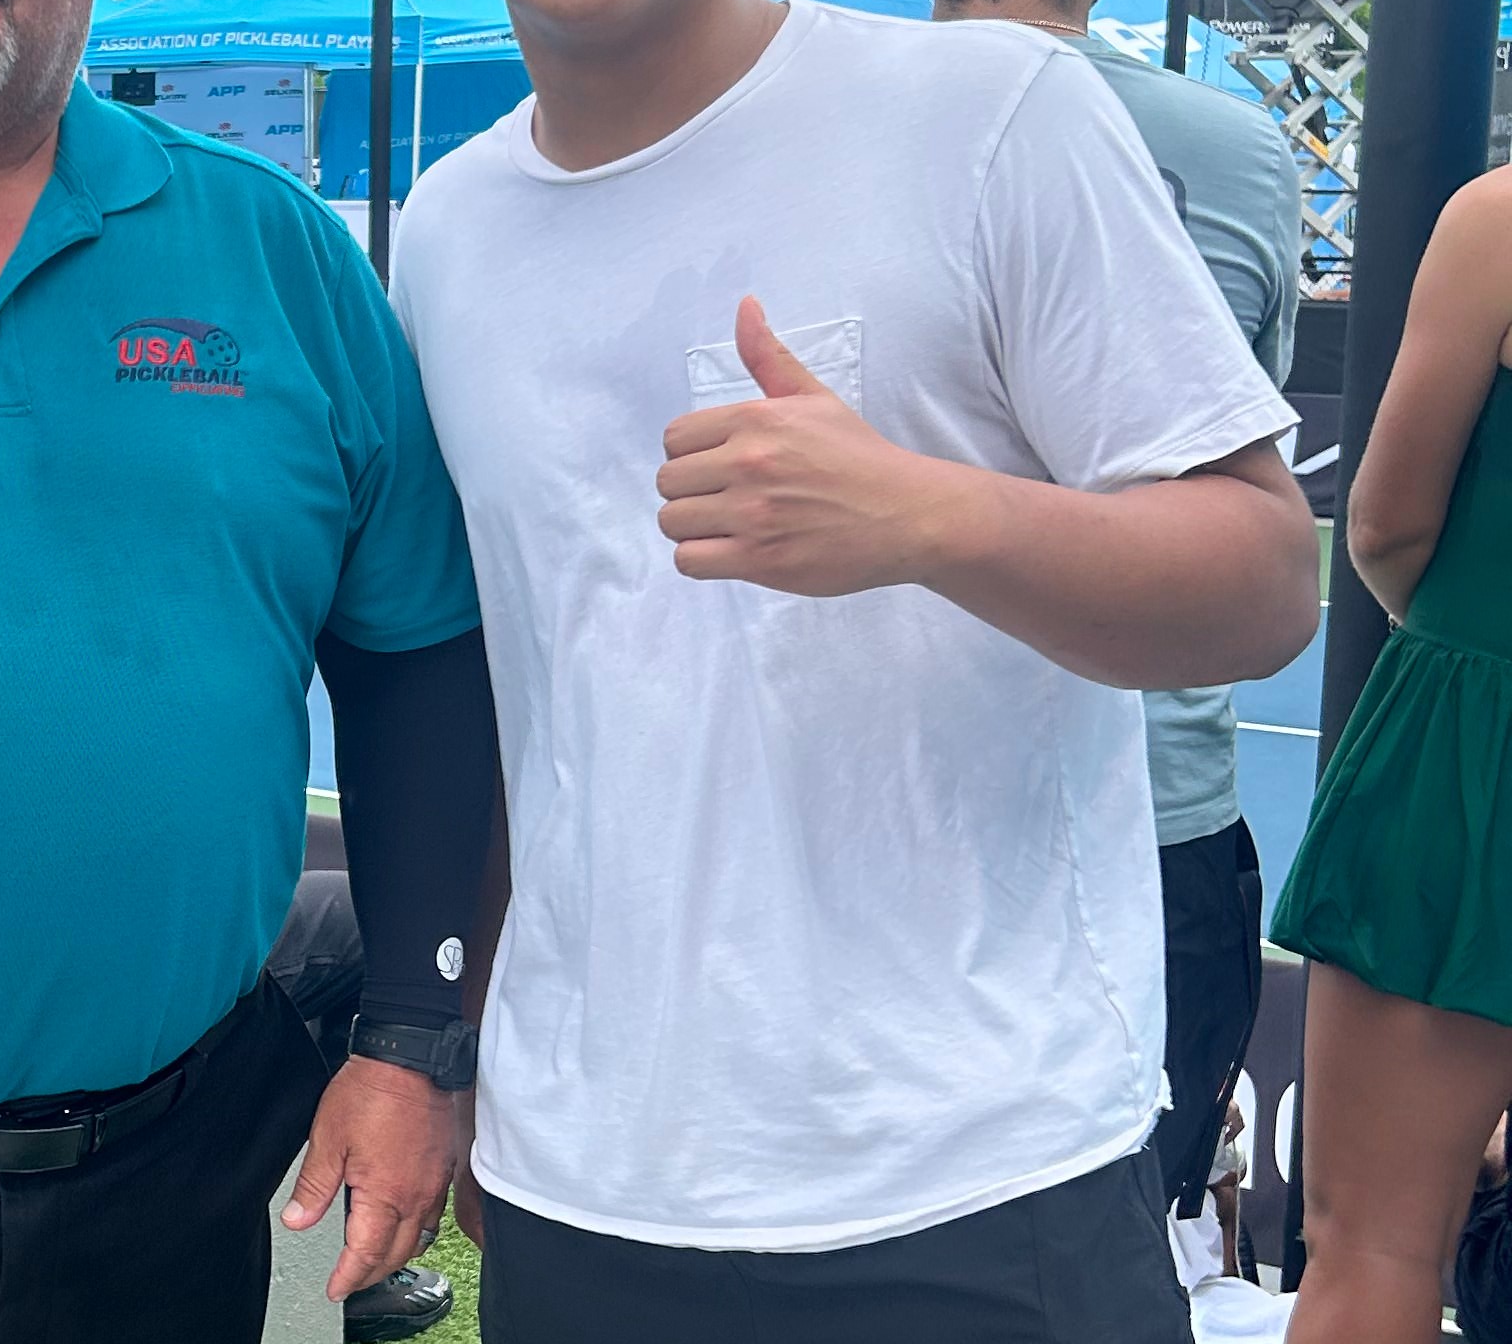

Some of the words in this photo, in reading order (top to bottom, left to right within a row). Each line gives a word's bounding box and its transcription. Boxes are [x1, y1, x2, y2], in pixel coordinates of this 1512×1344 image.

[97, 34, 197, 52] ASSOCIATION
[201, 32, 221, 47] OF
[225, 31, 322, 49] PICKLEBALL
[326, 34, 401, 50] PLAYS
[208, 85, 246, 97] APP
[265, 124, 303, 136] APP
[118, 337, 197, 367] USA
[115, 365, 245, 386] PICKLEBALL
